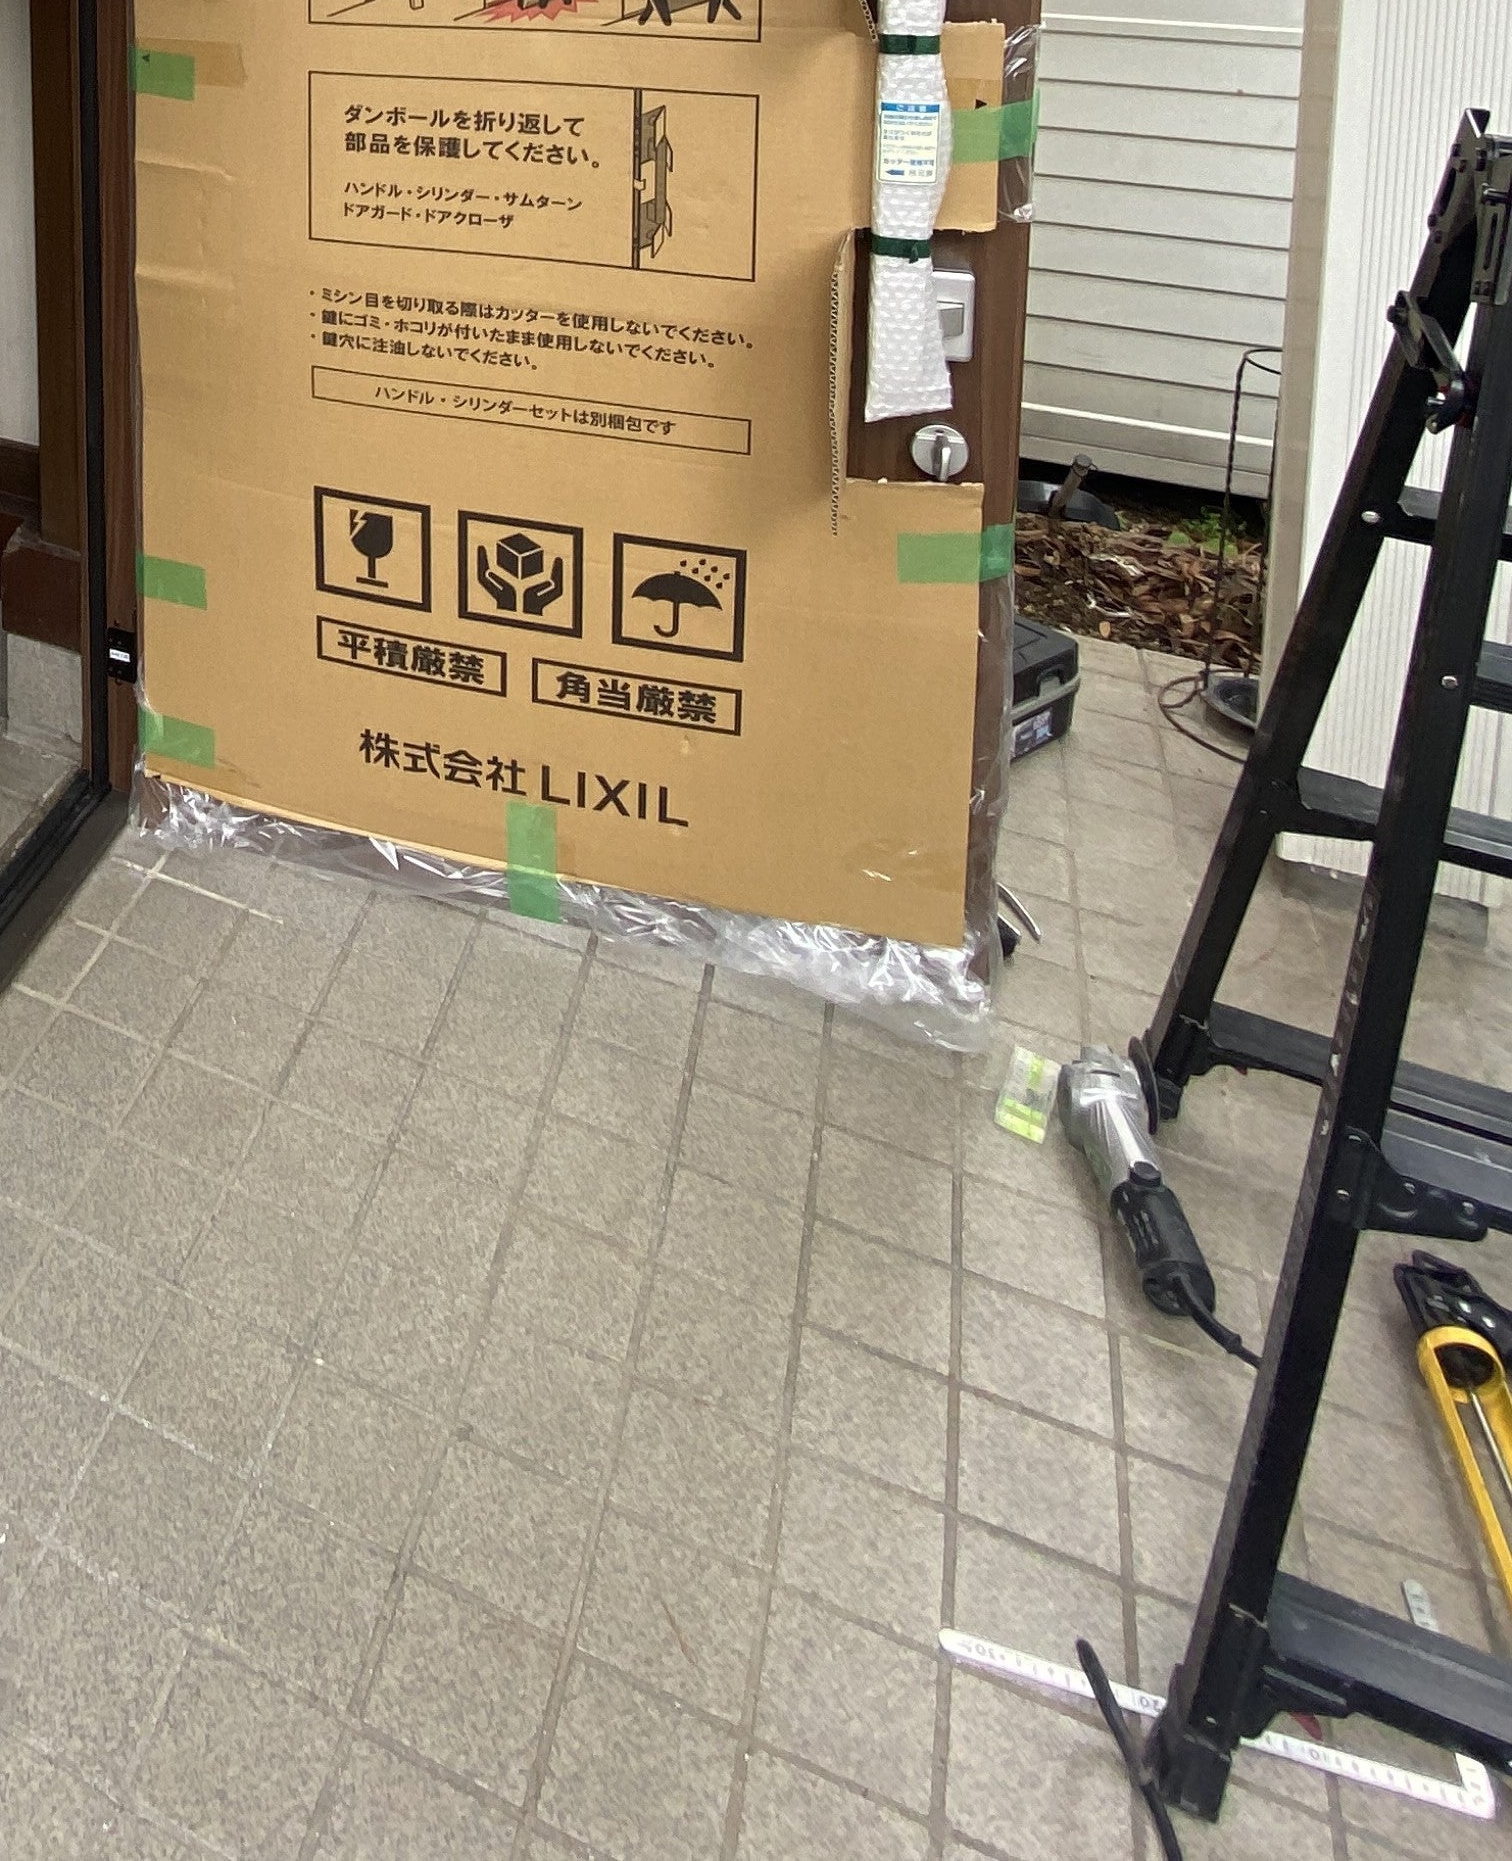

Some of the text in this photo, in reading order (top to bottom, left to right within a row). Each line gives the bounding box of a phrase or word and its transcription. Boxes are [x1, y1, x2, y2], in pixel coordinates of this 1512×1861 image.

[344, 104, 586, 137] ダンボールを折り返して
[344, 131, 600, 169] 部品を保護してください。
[343, 202, 515, 229] ドアガード・ドアクローザ
[344, 181, 583, 211] ハンドル・シリンダー・サムターン
[375, 385, 677, 436] ハンドル・シリンダーセットは別梱包です
[338, 628, 485, 686] 平積厳禁
[555, 671, 718, 725] 角当厳禁
[359, 728, 689, 828] 株式会社 LIXIL
